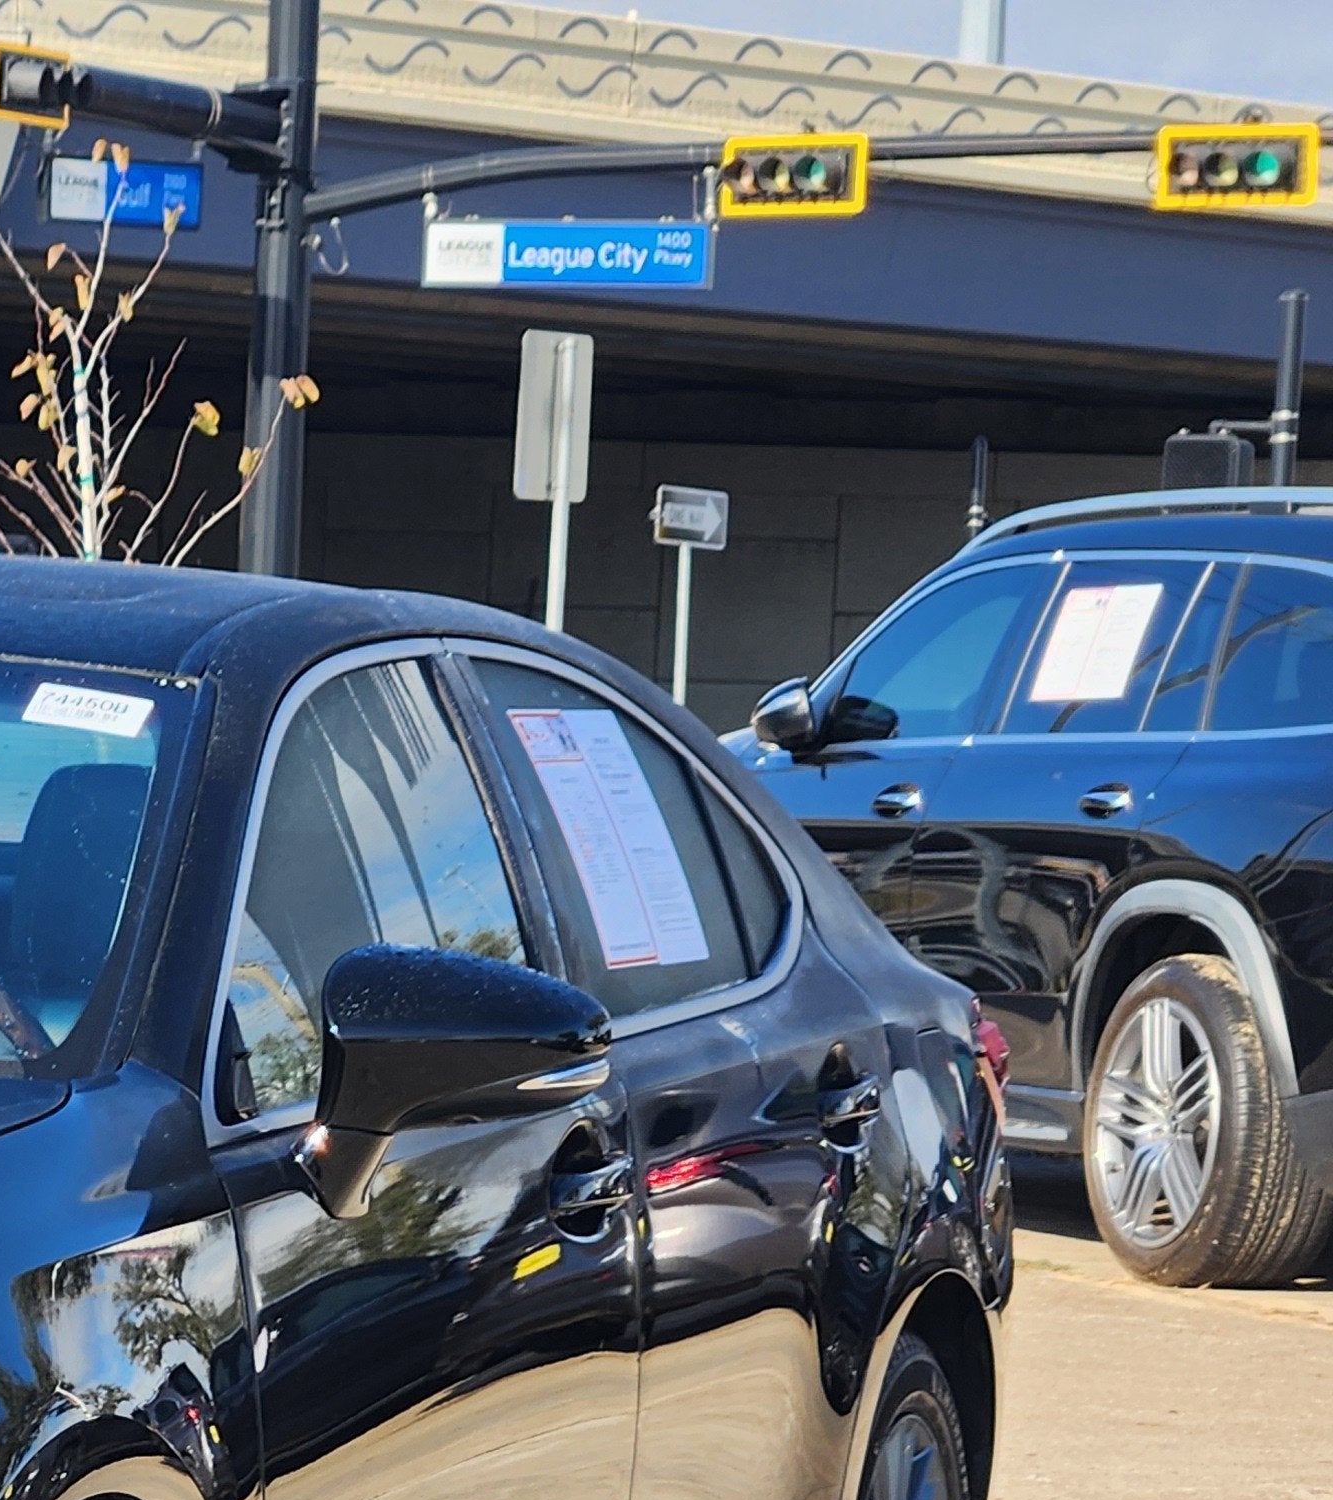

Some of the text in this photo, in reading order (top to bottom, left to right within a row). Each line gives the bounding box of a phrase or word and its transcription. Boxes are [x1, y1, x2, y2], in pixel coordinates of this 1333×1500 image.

[657, 231, 692, 249] 1400
[507, 241, 595, 275] League
[597, 240, 649, 275] City
[653, 249, 692, 269] Pkwy
